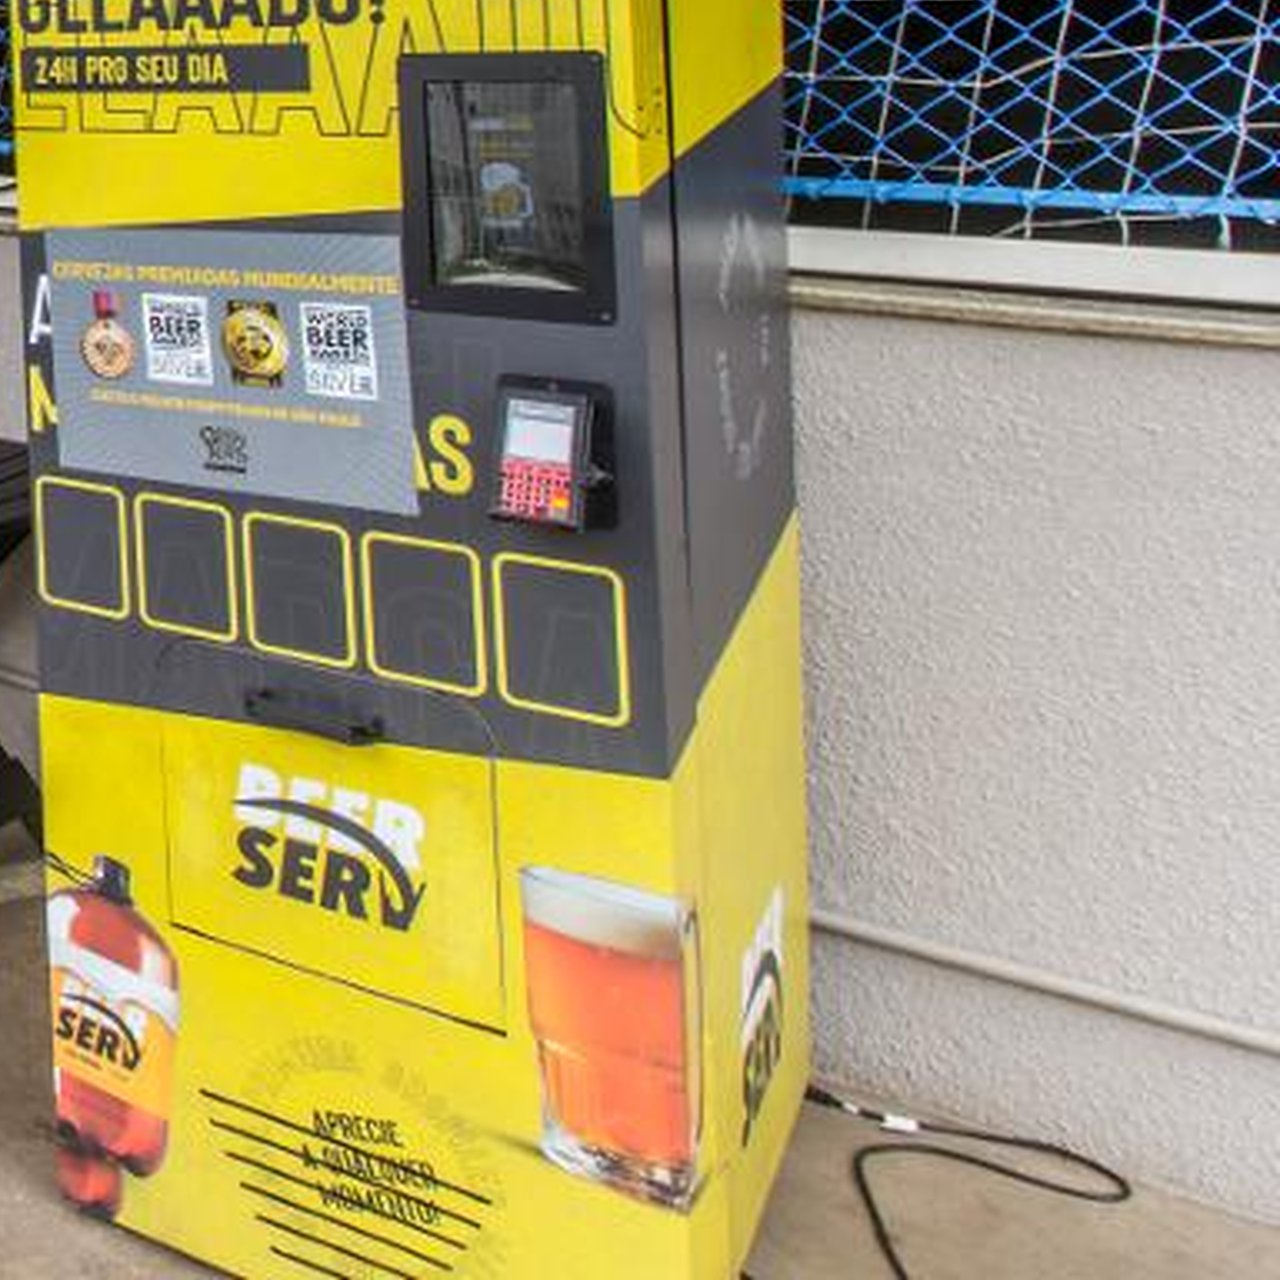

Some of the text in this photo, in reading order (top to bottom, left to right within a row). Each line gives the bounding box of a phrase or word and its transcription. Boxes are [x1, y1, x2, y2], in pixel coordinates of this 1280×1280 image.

[35, 53, 229, 84] 24H PRO SEU DIA
[148, 315, 202, 335] BEER
[305, 327, 370, 352] BEER
[234, 761, 426, 871] BEER
